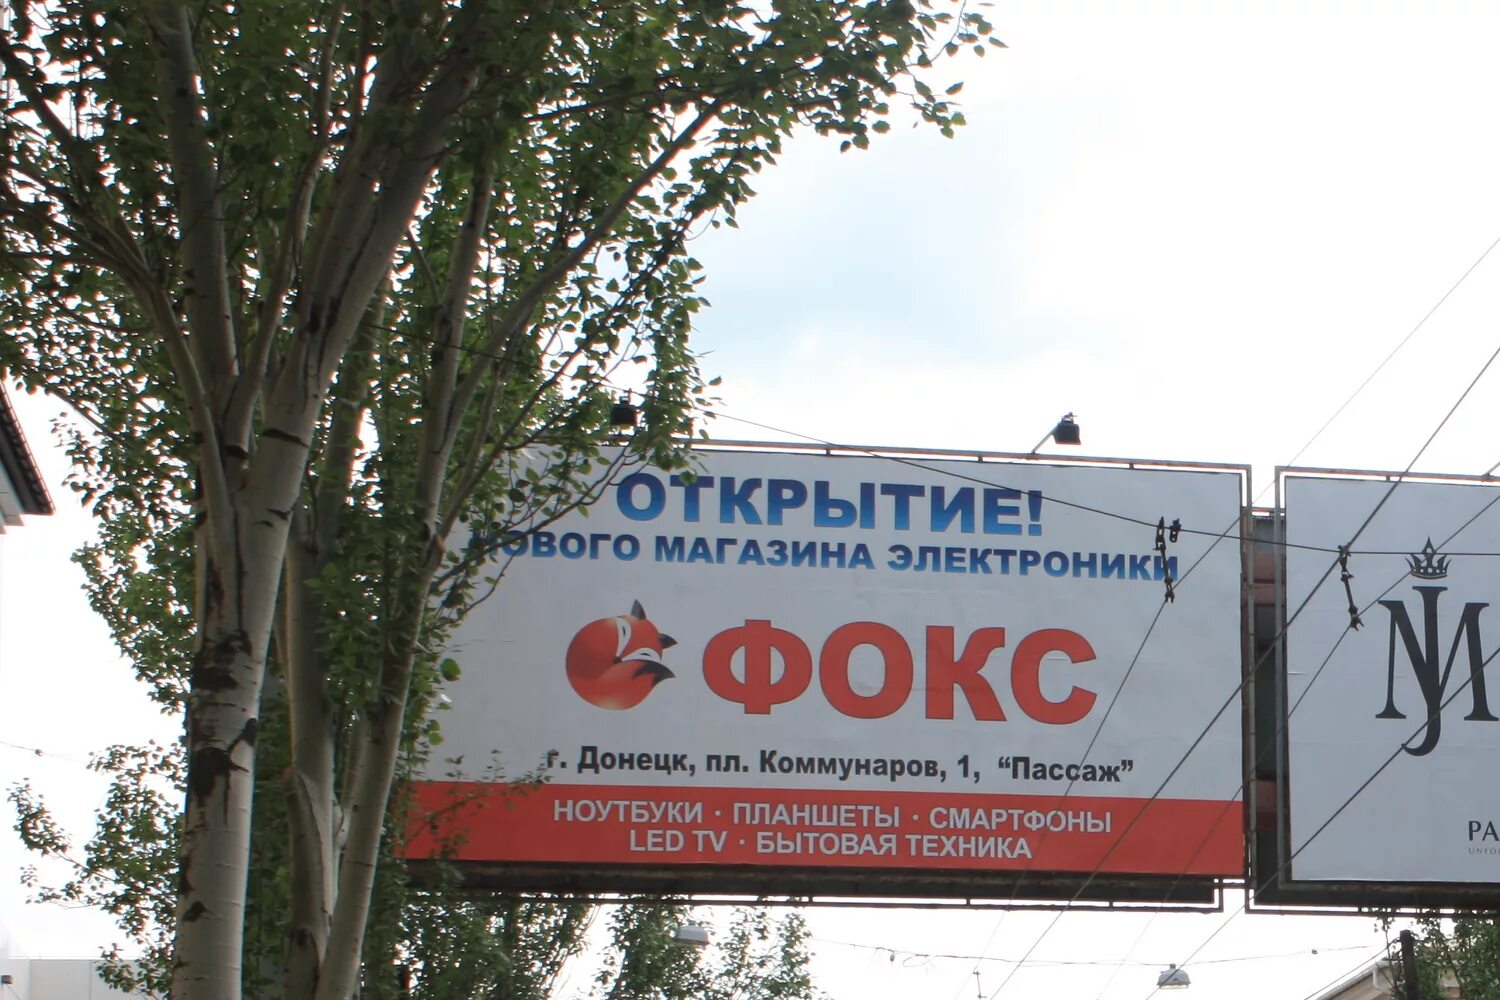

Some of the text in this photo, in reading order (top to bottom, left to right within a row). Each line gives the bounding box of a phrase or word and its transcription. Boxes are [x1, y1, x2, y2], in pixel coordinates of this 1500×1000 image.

[616, 472, 1043, 537] ОТКРЫТИЕ!
[654, 535, 876, 570] МАГАЗИНА
[887, 544, 1179, 582] ЭЛЕКТРОНИКИ
[701, 618, 1098, 726] ФОКС
[577, 745, 697, 778] Донецк,
[705, 753, 750, 773] пл.
[759, 749, 947, 783] Коммунаров,
[956, 754, 981, 784] 1,
[552, 799, 1112, 833] НОУТБУКИ ПЛАНШЕТЫ СМАРТФОНЫ
[629, 828, 1033, 859] LED TV БЫТОВАЯ ТЕХНИКА
